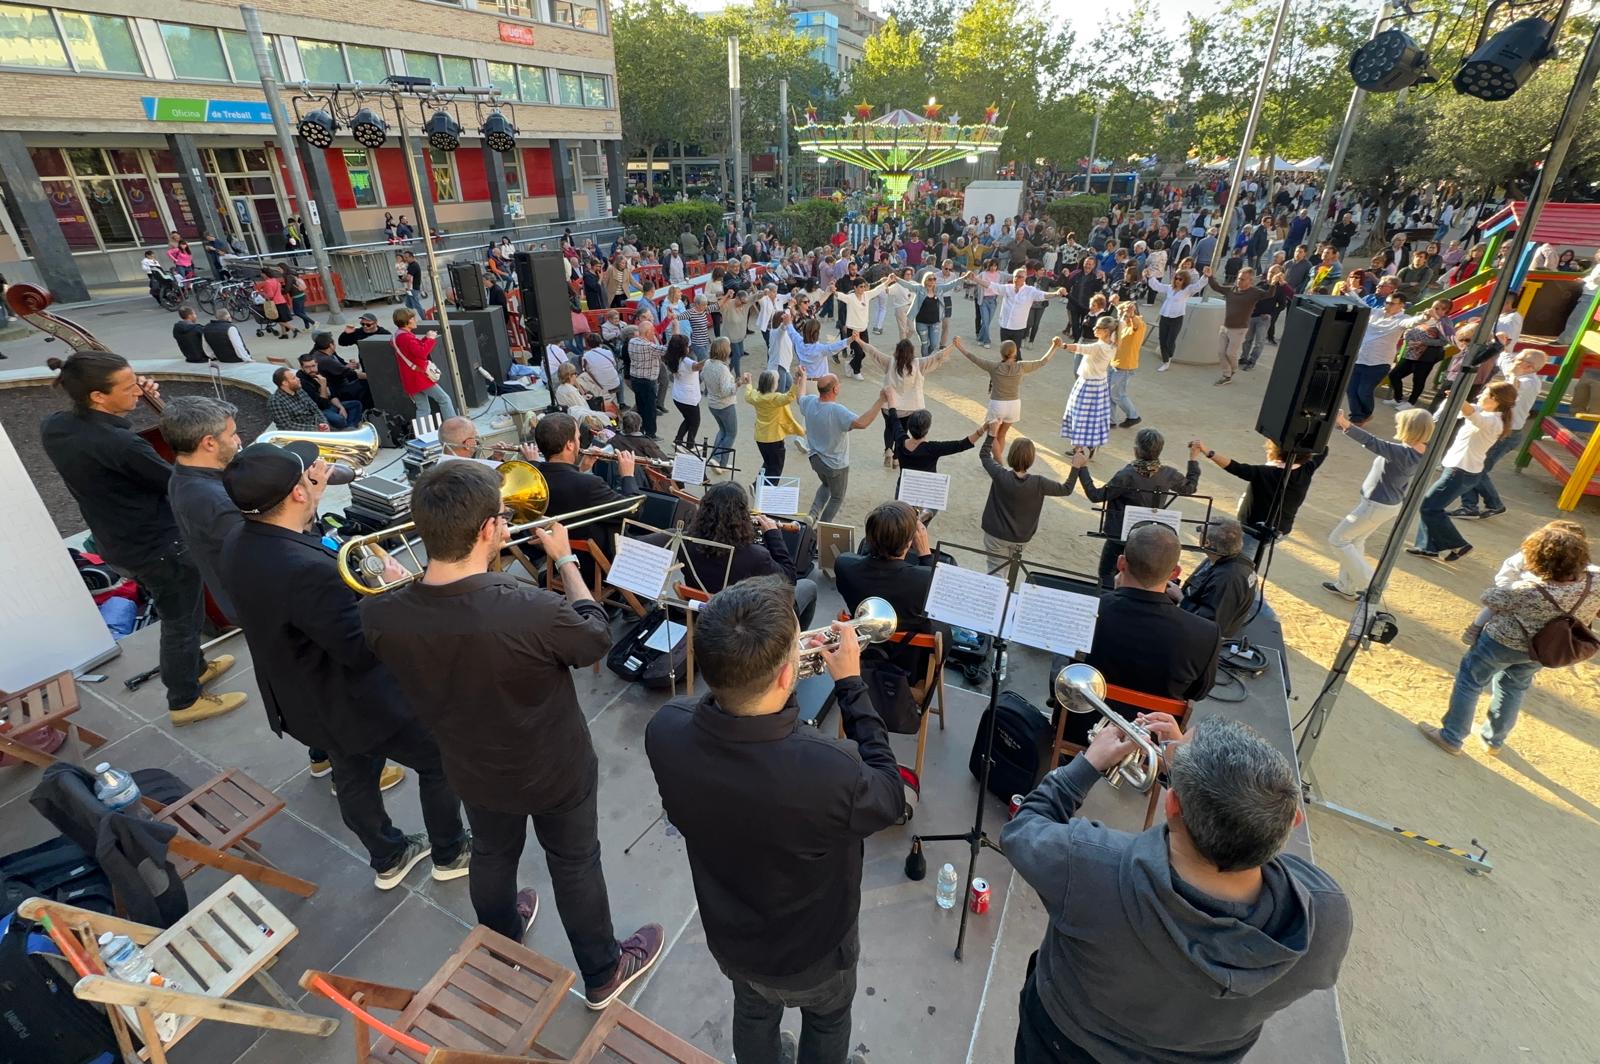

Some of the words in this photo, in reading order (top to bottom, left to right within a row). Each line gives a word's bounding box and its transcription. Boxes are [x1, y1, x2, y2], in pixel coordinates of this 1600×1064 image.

[171, 109, 200, 118] Oficina
[211, 110, 222, 118] de
[223, 109, 252, 119] Treball
